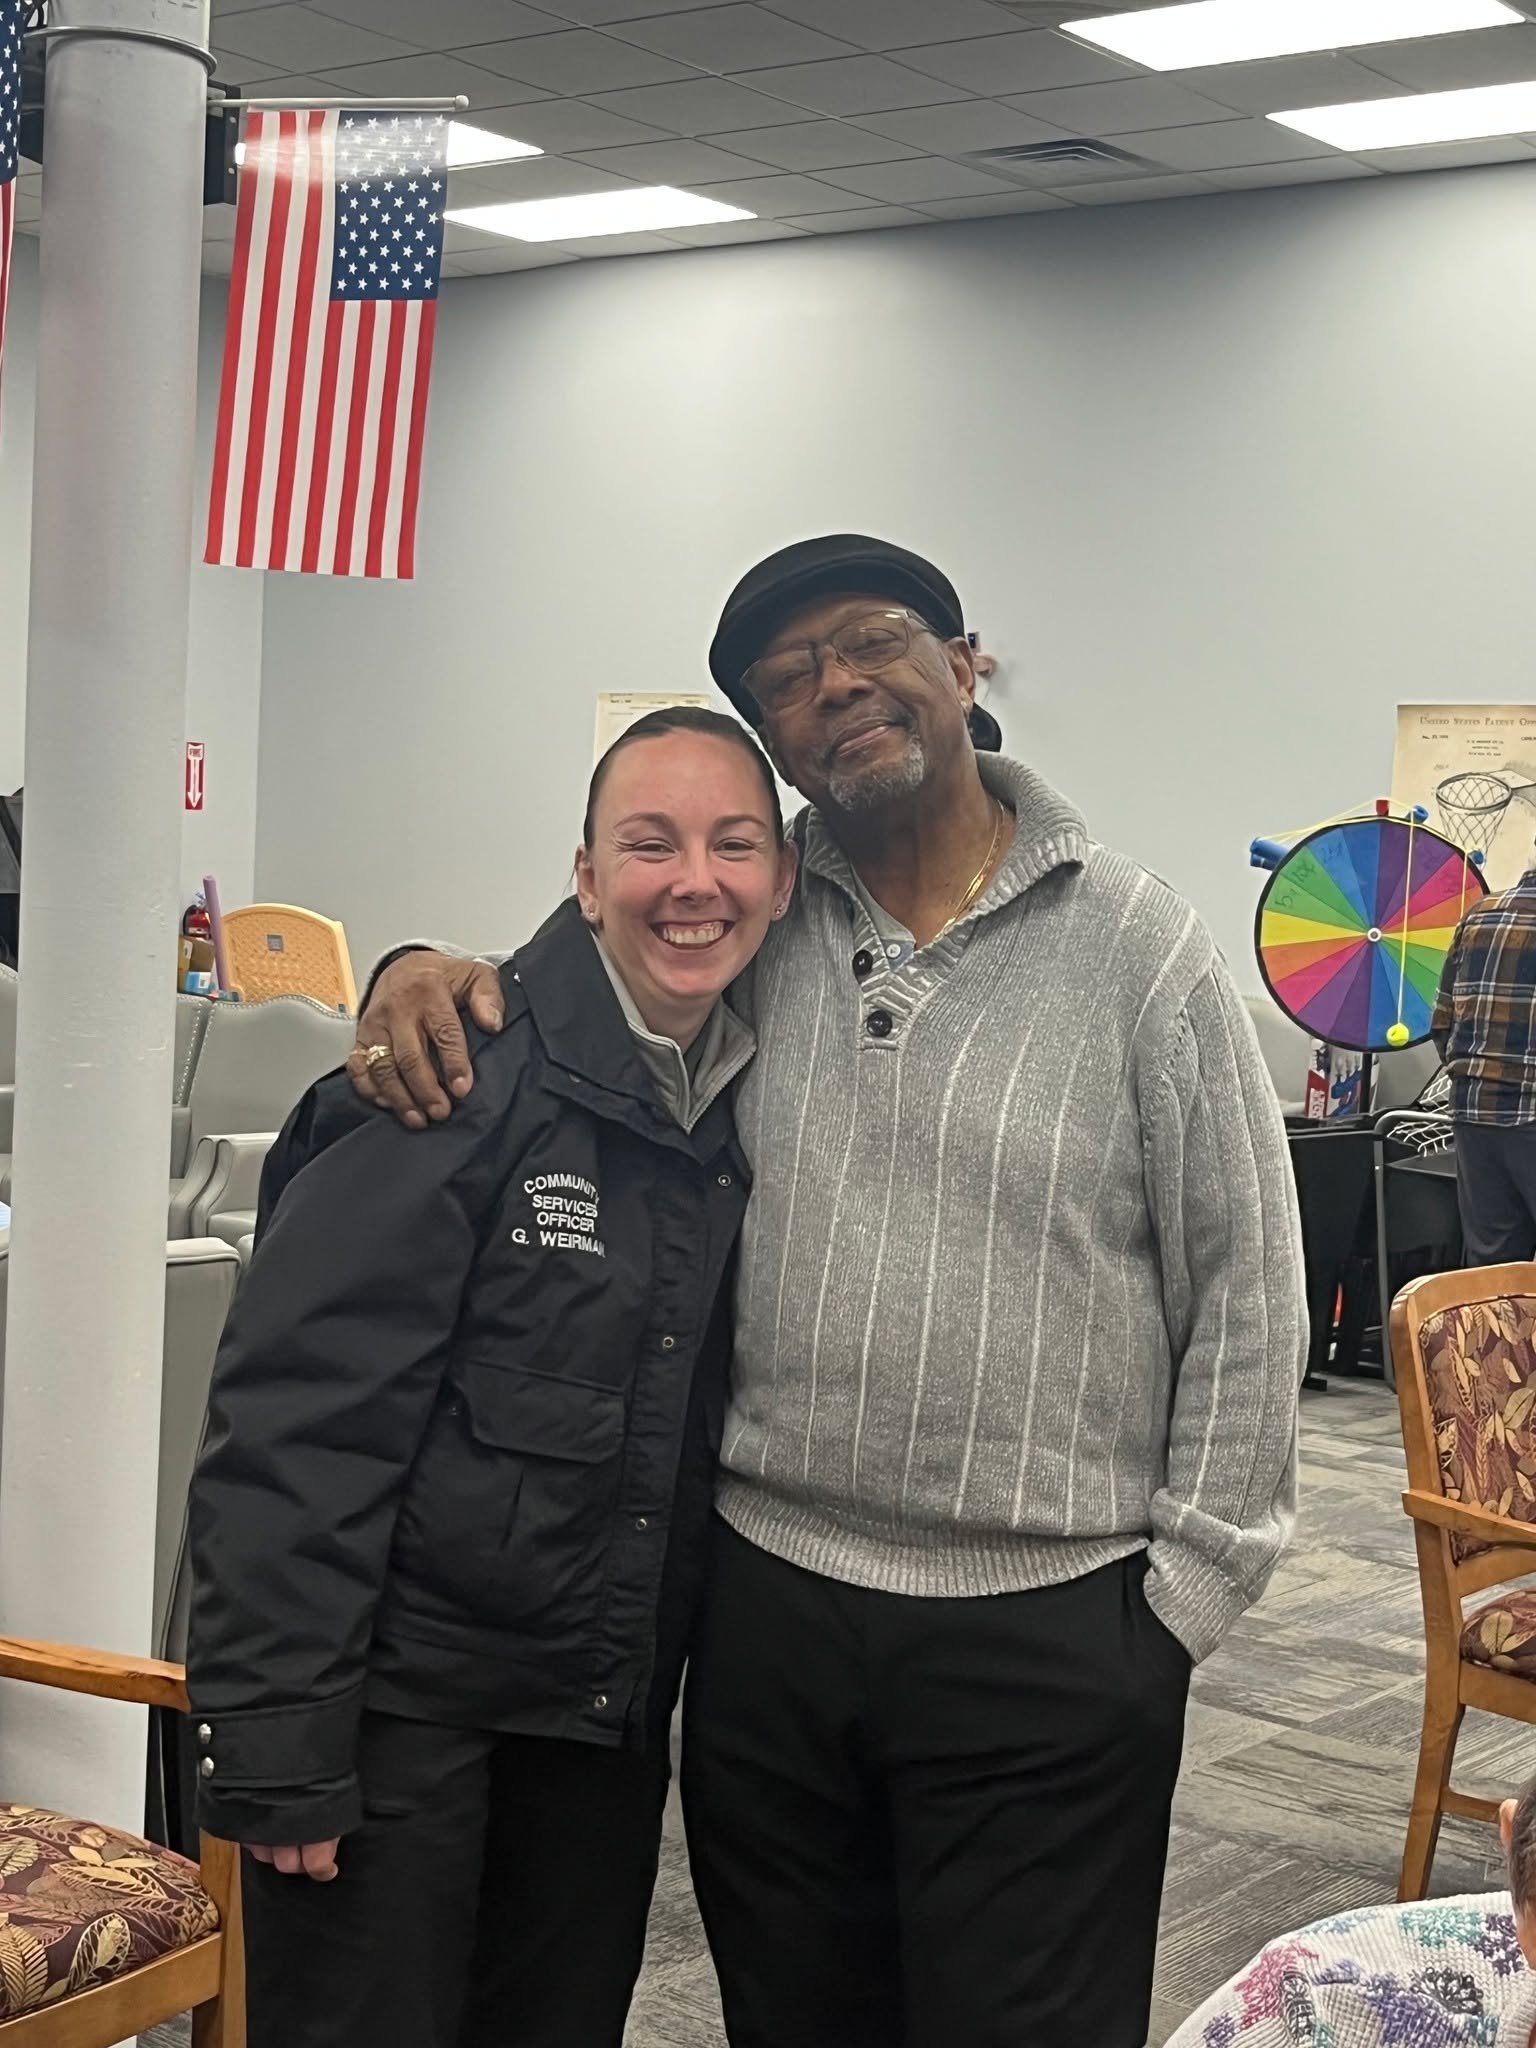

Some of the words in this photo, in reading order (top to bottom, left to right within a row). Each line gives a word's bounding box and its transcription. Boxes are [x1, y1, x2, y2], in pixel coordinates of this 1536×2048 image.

[523, 1173, 600, 1205] COMMUNITY
[531, 1194, 598, 1218] SERVICES
[536, 1211, 595, 1233] OFFICER
[511, 1228, 530, 1245] G.
